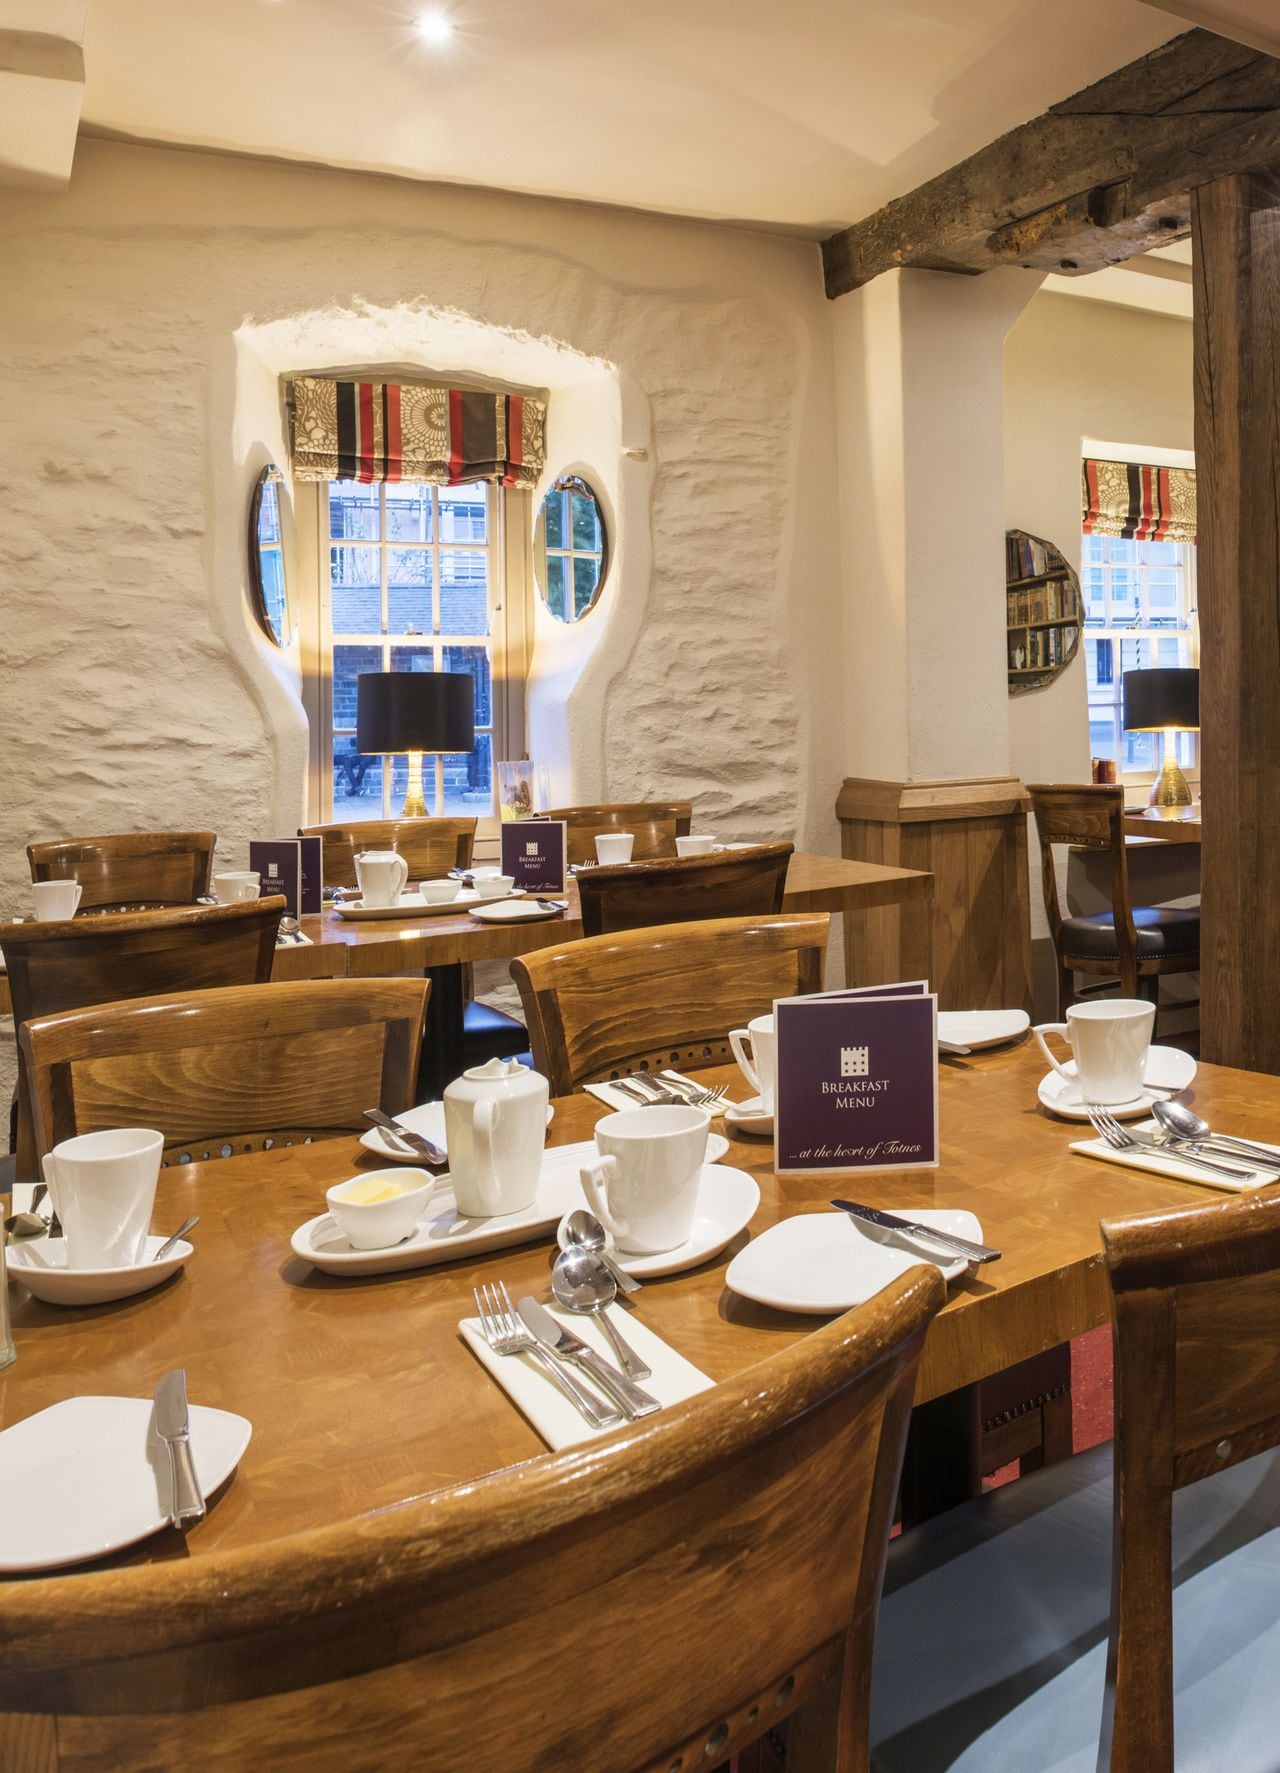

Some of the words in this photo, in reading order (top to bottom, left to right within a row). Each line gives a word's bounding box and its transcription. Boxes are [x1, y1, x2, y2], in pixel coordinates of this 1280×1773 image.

[821, 1080, 890, 1094] BREAKFAST
[836, 1097, 875, 1109] MENU
[814, 1144, 833, 1157] the
[864, 1141, 884, 1160] of
[882, 1140, 921, 1155] Totnes
